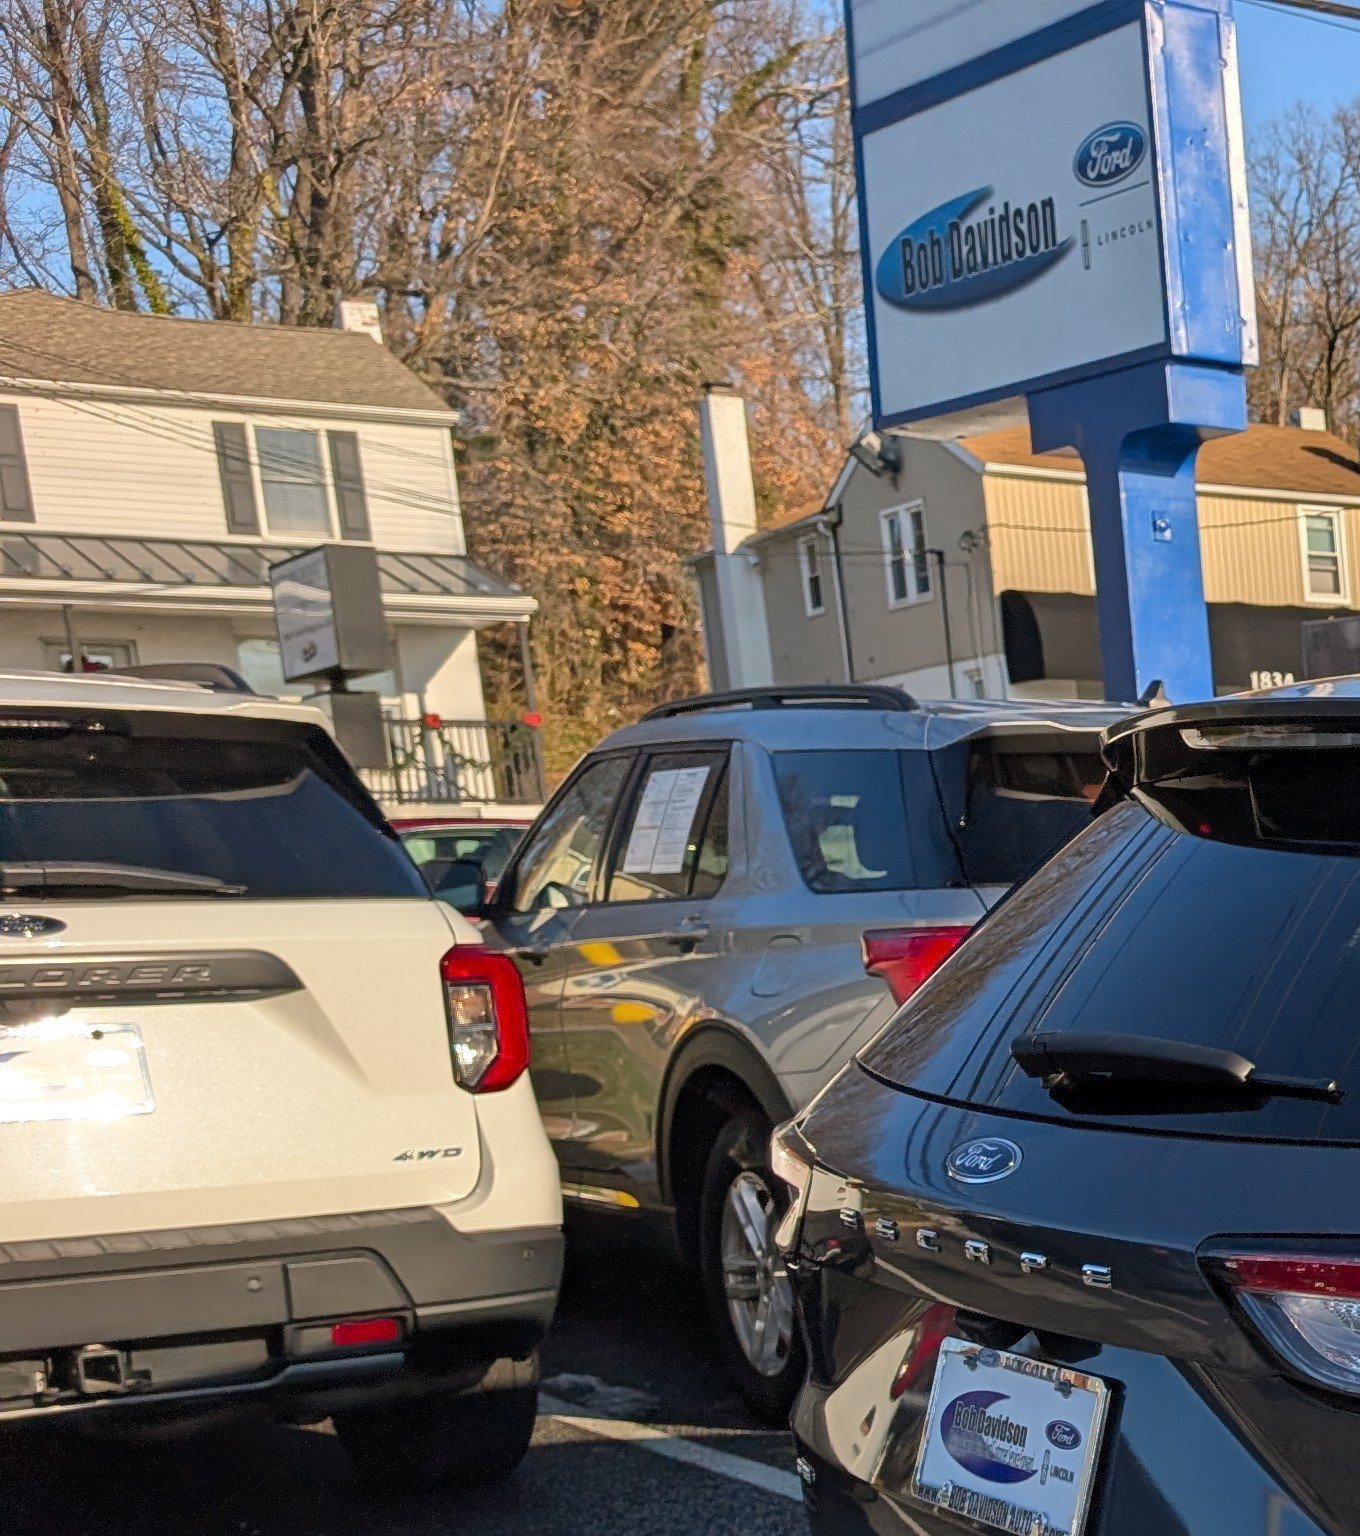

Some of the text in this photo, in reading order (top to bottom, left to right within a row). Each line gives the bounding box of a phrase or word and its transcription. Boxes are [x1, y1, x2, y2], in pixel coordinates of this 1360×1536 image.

[1086, 132, 1134, 179] Ford
[901, 195, 1058, 295] Bob Davidson
[1096, 218, 1155, 247] LINCOLN
[392, 1146, 463, 1162] 4WD
[954, 1142, 1003, 1171] Ford
[839, 1206, 1113, 1290] ESCAPE
[953, 1400, 1029, 1449] Bob Davidson
[1049, 1464, 1076, 1485] LINCOLN
